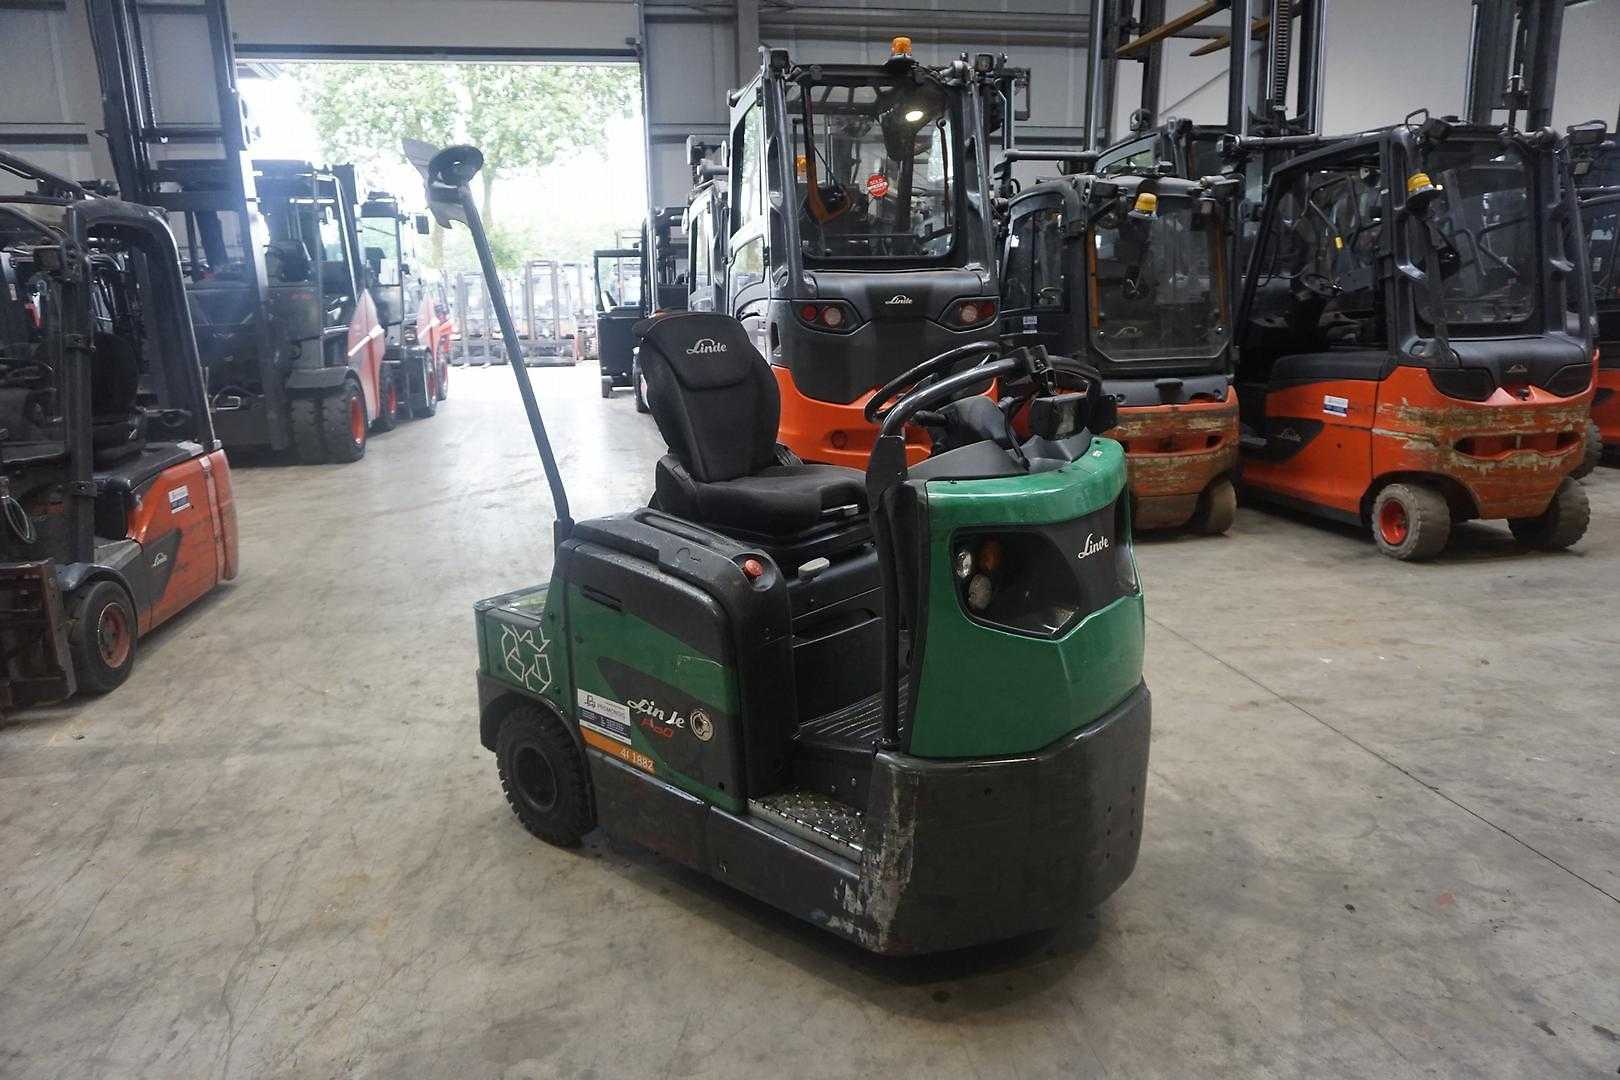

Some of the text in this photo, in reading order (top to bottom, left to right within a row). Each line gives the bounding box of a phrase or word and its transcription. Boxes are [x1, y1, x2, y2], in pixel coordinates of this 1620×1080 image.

[885, 294, 913, 305] Linde
[686, 338, 728, 354] Linde
[1077, 533, 1109, 559] Linde
